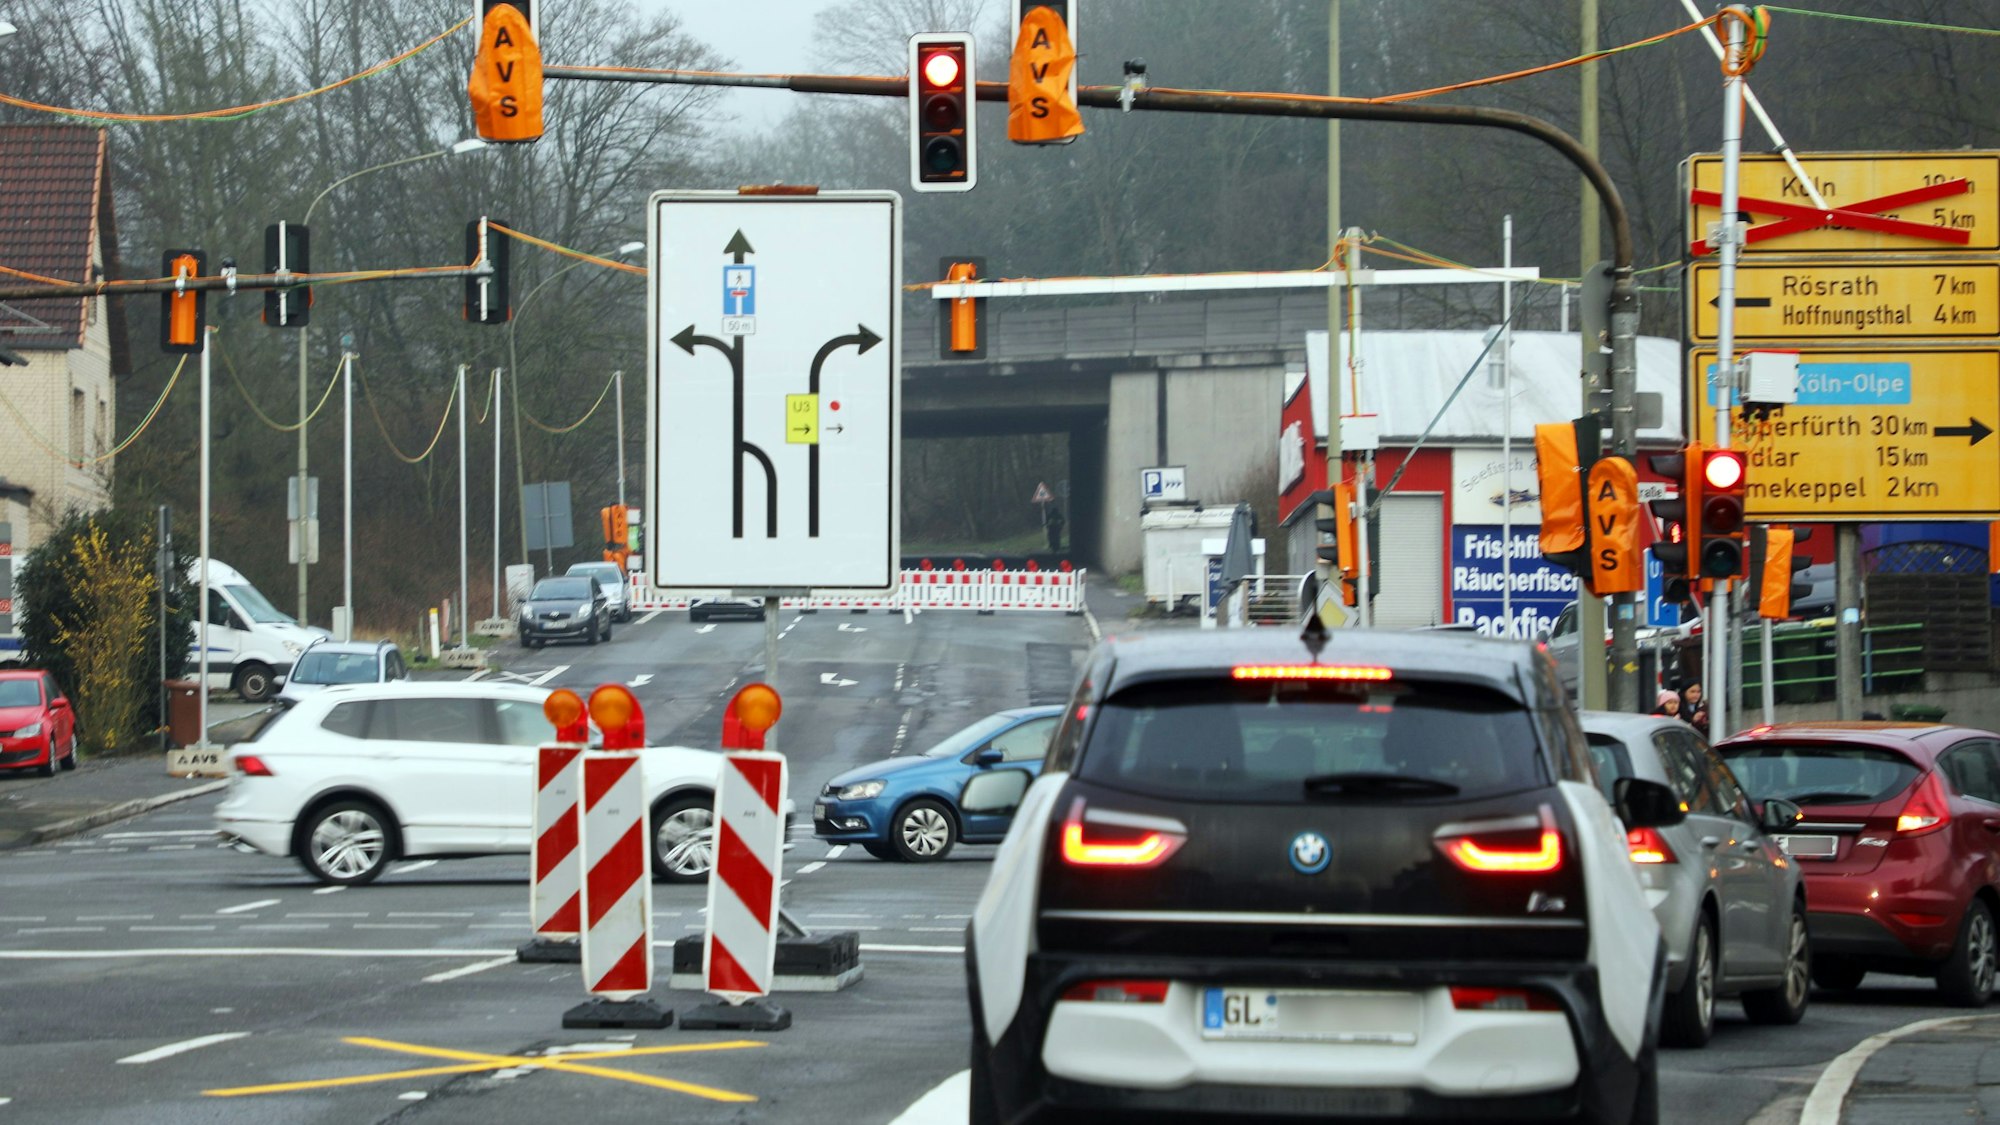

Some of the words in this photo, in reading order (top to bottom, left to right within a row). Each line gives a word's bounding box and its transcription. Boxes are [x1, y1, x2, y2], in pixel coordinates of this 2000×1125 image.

[494, 26, 519, 118] AVS
[1031, 27, 1051, 119] AVS
[1933, 207, 1947, 227] 5
[1951, 209, 1976, 228] km
[1783, 275, 1878, 297] Rösrath
[1934, 274, 1946, 295] 7
[1951, 276, 1976, 295] km
[728, 320, 740, 331] 50
[1783, 304, 1911, 330] Hoffnungsthal
[1933, 304, 1947, 324] 4
[1951, 305, 1976, 324] km
[793, 401, 810, 413] U3
[1871, 415, 1899, 436] 30
[1904, 417, 1927, 435] km
[1746, 447, 1800, 467] dlar
[1877, 446, 1899, 467] 15
[1904, 448, 1928, 467] km
[1745, 477, 1866, 503] mekeppel
[1887, 476, 1900, 497] 2
[1904, 476, 1939, 497] km
[1598, 479, 1618, 571] AVS
[1464, 533, 1542, 559] Frischfi
[191, 753, 218, 764] AVS
[1223, 994, 1261, 1026] GL
